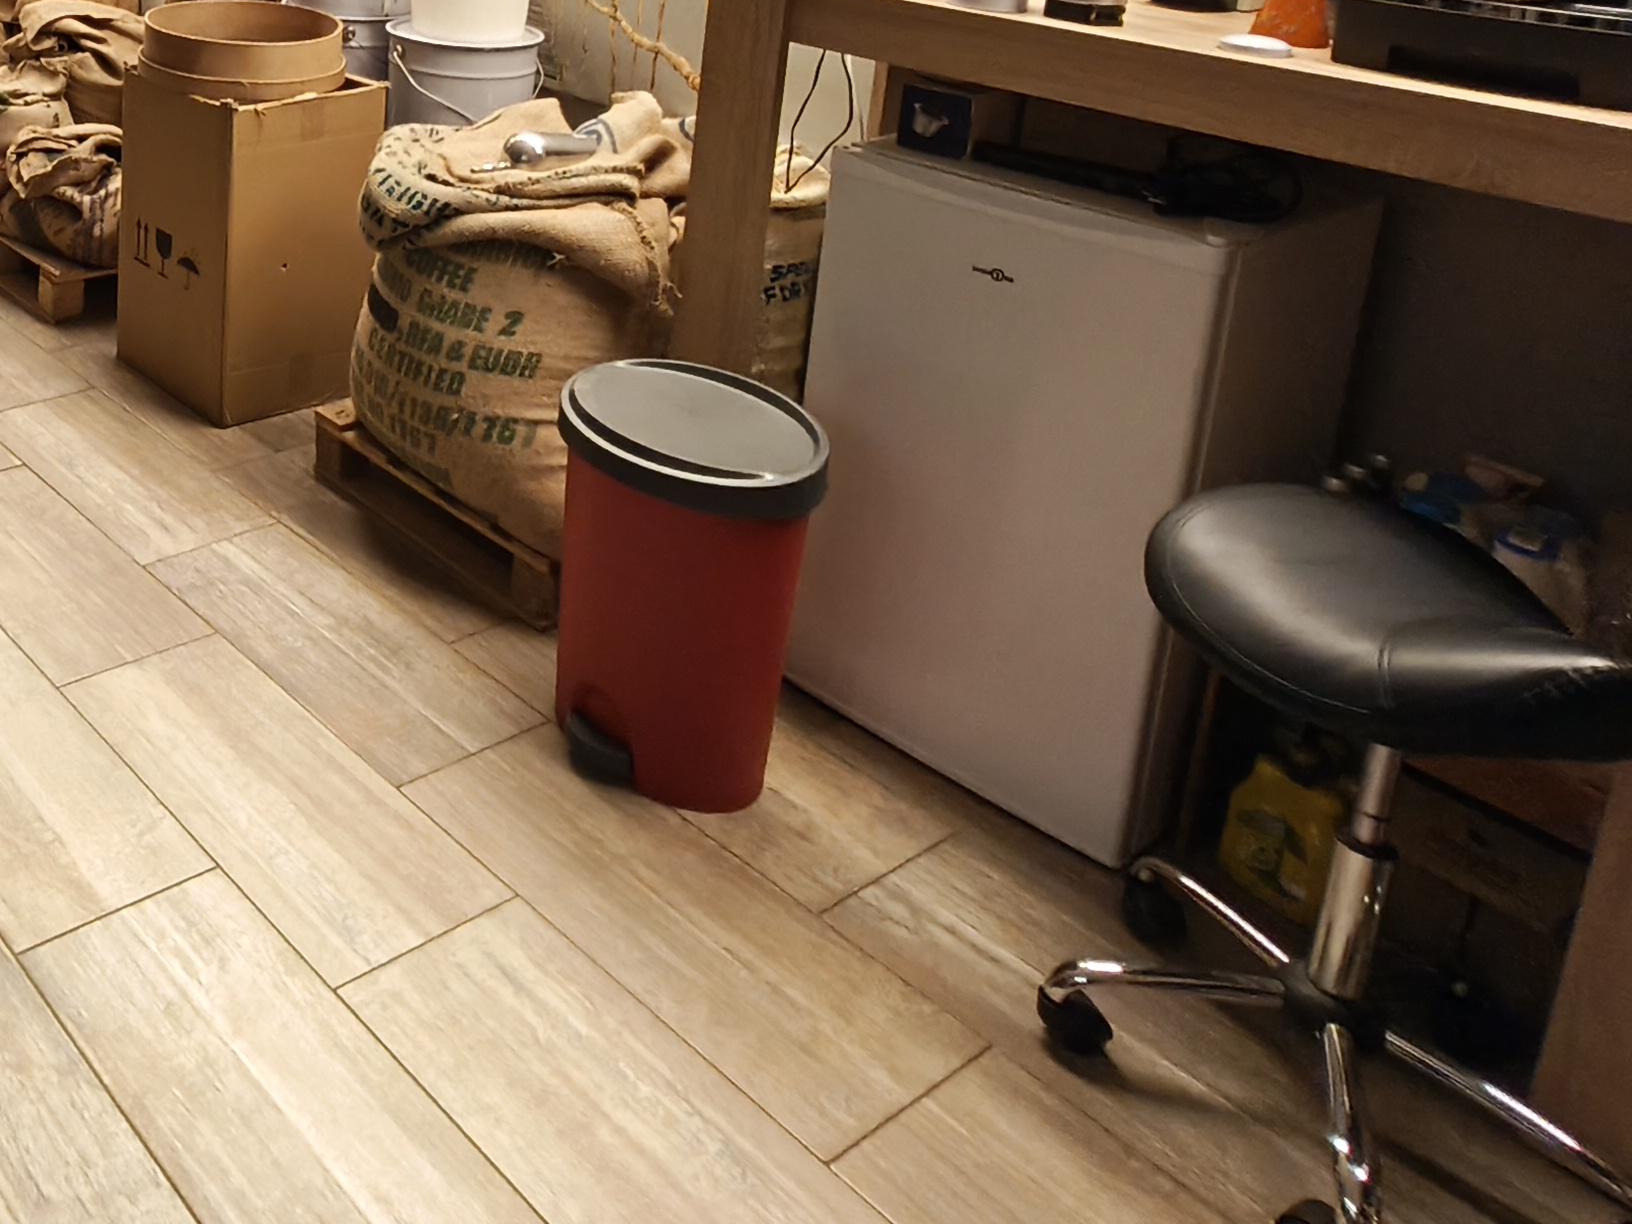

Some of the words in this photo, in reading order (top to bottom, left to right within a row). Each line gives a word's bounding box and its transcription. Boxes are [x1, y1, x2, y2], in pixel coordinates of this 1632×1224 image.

[403, 248, 479, 293] COFFEE
[418, 287, 493, 334] GRADE
[496, 310, 526, 338] 2
[368, 327, 467, 396] CERTIFIED
